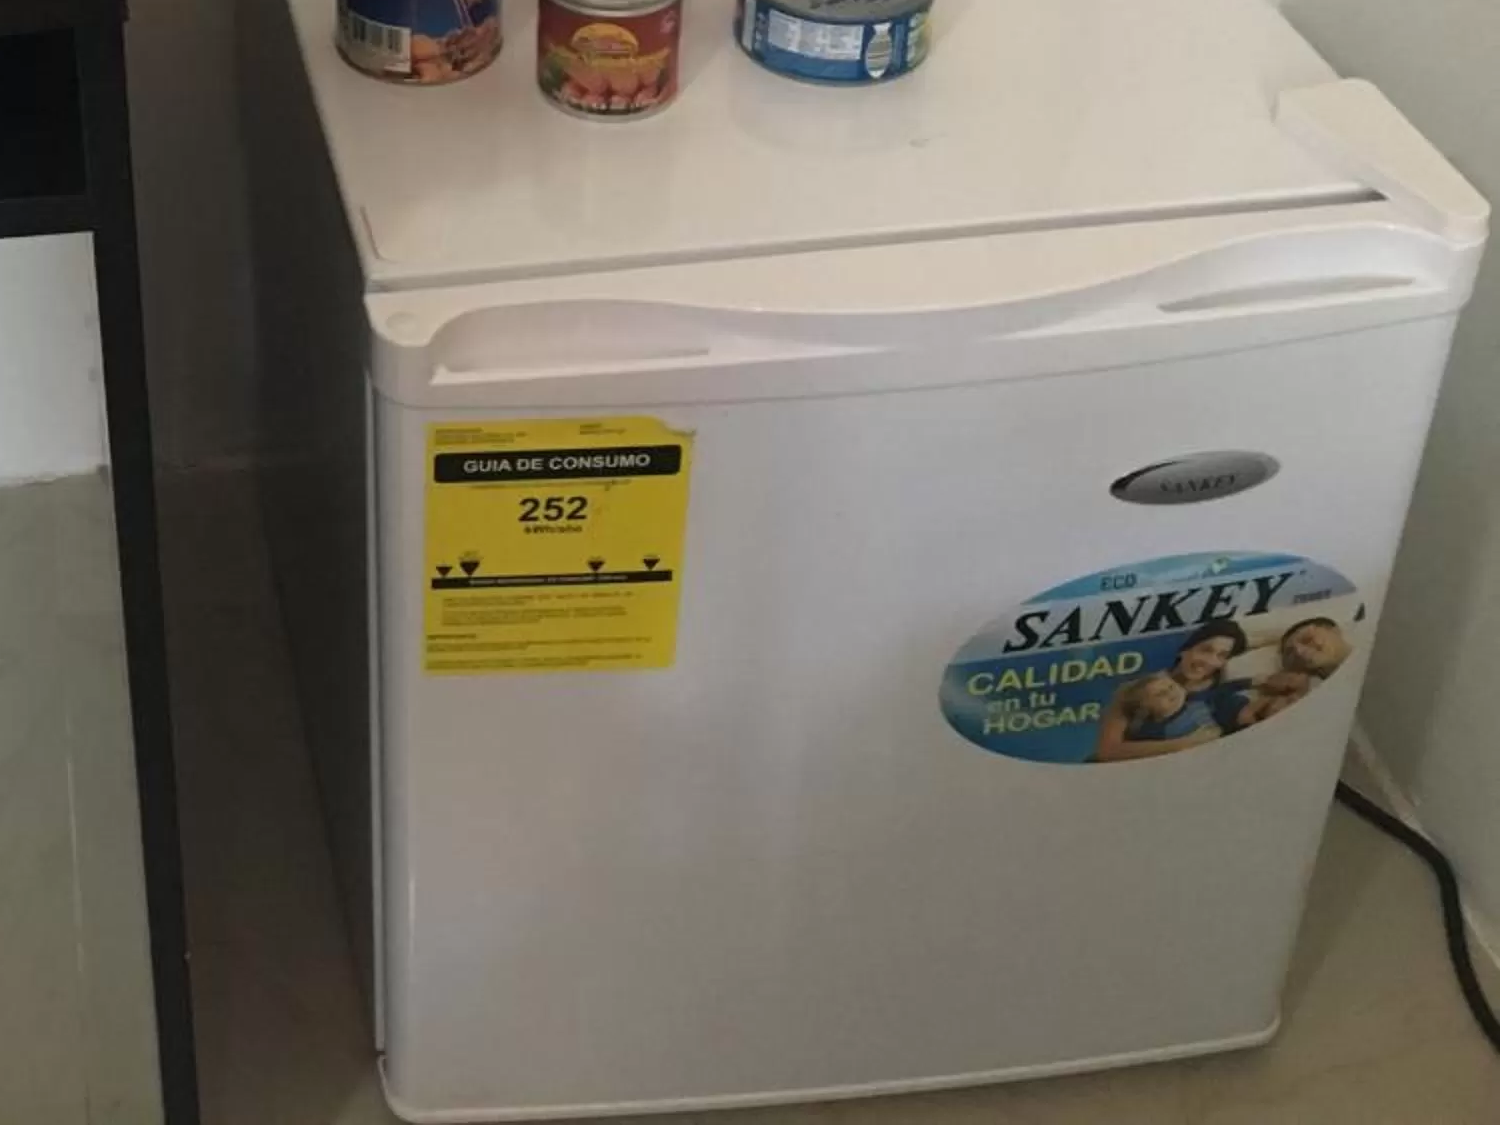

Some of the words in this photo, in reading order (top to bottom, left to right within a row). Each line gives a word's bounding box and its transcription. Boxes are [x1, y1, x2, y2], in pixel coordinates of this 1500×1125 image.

[463, 459, 511, 473] GUIA
[517, 457, 542, 471] DE
[549, 454, 651, 470] CONSUMO
[518, 496, 588, 521] 252
[1100, 573, 1137, 590] ECO
[1002, 573, 1294, 652] SANKEY
[966, 652, 1144, 696] CALIDAD
[985, 694, 1021, 712] en
[1028, 691, 1056, 708] tu
[983, 702, 1101, 736] HOGAR
